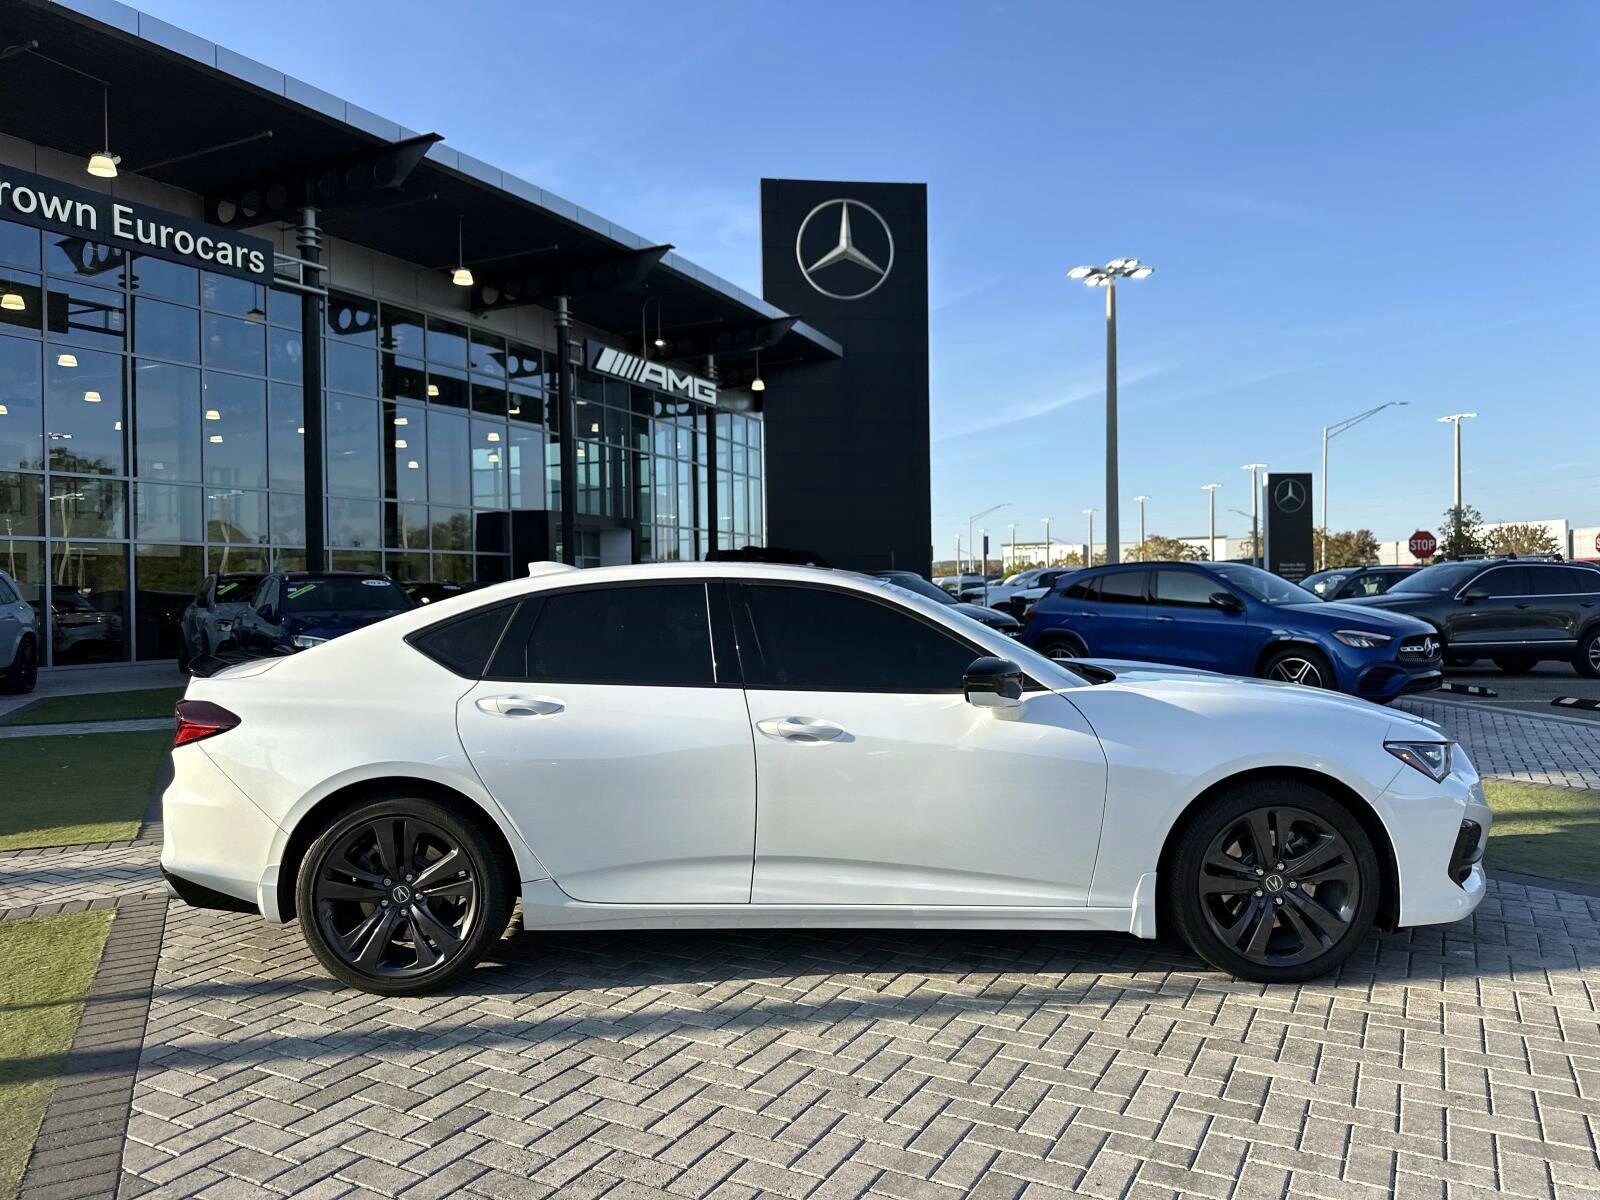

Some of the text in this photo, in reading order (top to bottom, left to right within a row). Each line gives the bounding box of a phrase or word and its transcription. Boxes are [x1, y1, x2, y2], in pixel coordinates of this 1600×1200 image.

[113, 203, 265, 274] Eurocars
[638, 361, 717, 405] AMG
[1410, 539, 1435, 551] STOP
